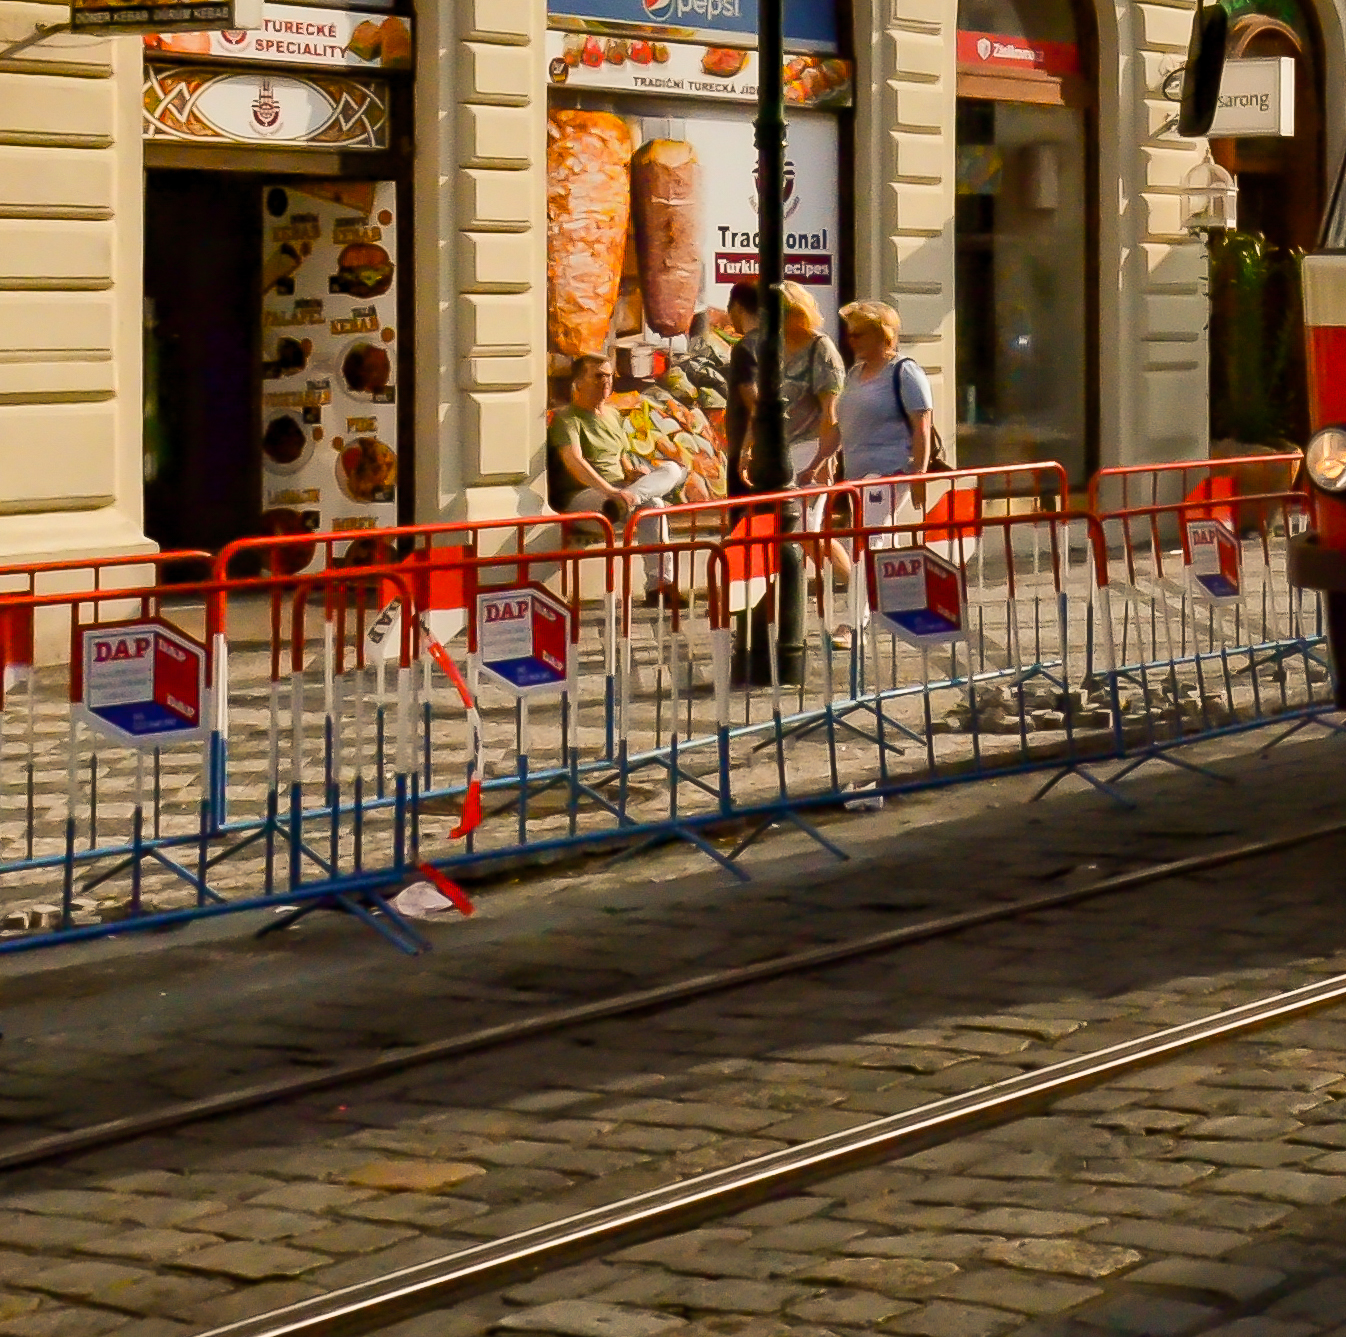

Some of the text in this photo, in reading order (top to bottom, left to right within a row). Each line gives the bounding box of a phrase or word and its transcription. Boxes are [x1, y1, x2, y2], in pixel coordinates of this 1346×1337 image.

[262, 17, 338, 39] TURECKÉ
[254, 38, 349, 59] SPECIALITY
[1217, 93, 1270, 112] sarong
[784, 260, 830, 279] ecipes
[882, 558, 922, 578] DAP
[484, 600, 529, 622] DAP
[93, 637, 151, 662] DAP
